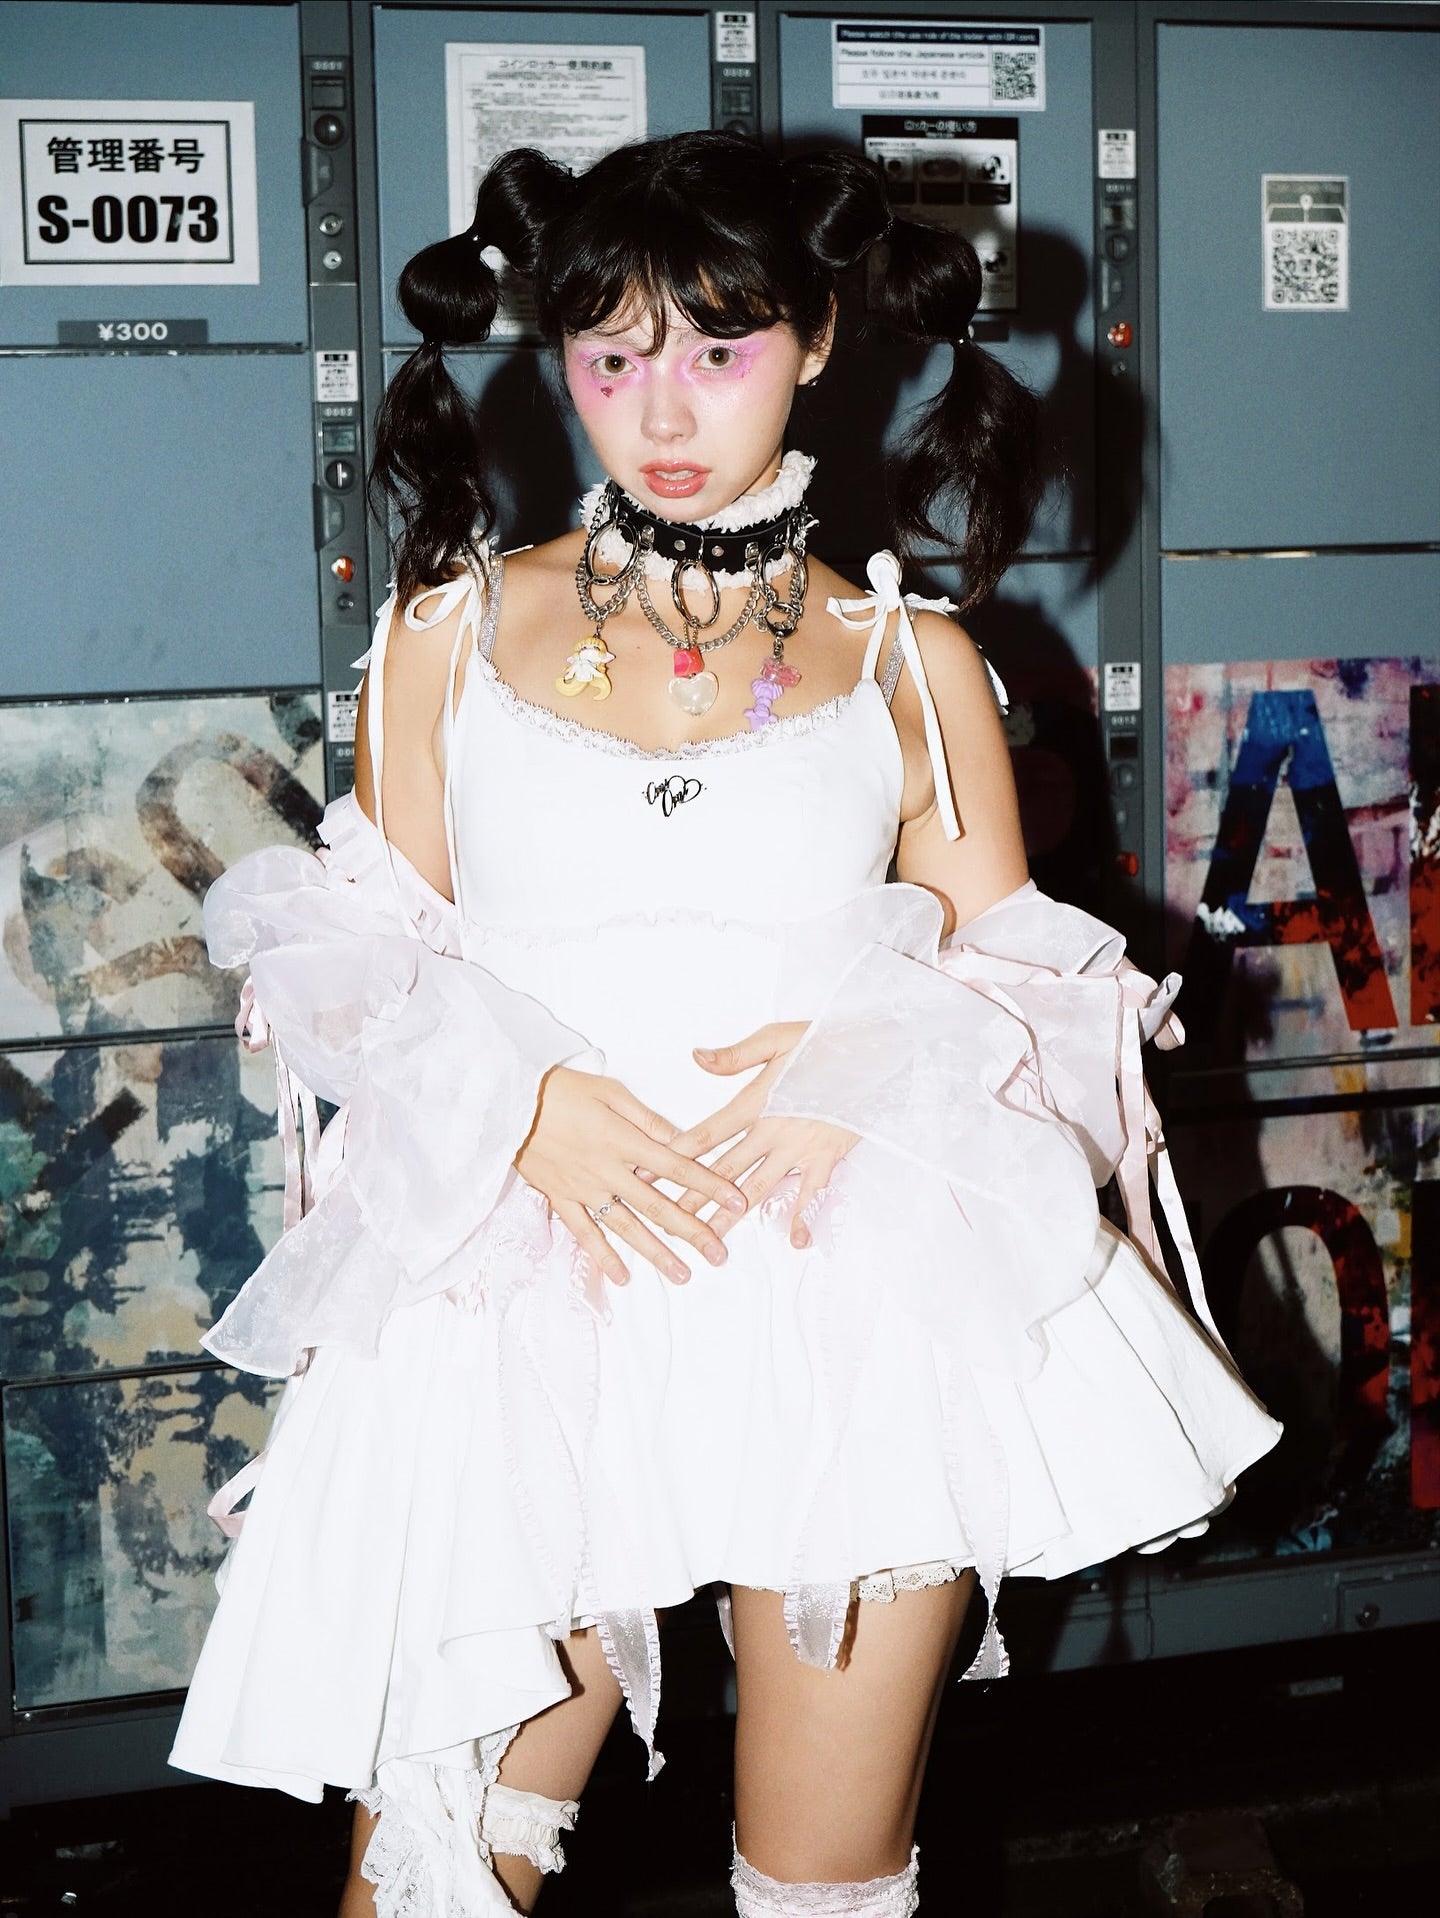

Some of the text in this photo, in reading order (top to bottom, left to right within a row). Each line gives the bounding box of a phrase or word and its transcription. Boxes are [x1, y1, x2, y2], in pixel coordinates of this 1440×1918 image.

[841, 49, 868, 57] Please
[870, 49, 895, 57] follow
[915, 51, 954, 59] Japanese
[47, 136, 205, 174] 管理番号
[37, 194, 219, 244] S-0073
[98, 322, 168, 342] ¥300
